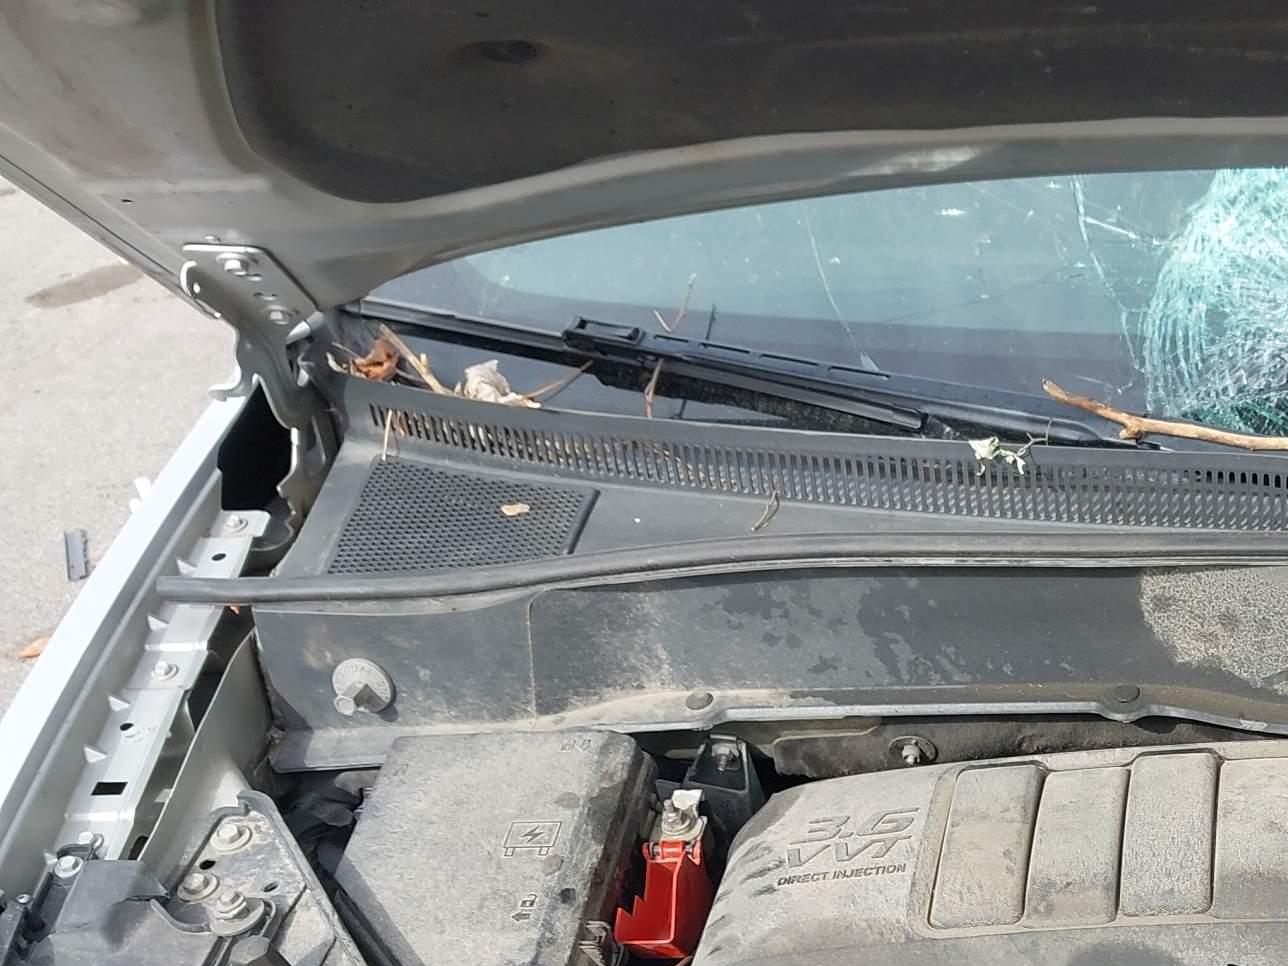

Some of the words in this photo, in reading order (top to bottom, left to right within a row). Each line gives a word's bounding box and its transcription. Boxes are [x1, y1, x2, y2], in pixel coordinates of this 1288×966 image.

[790, 807, 920, 845] 3.6
[787, 835, 912, 868] VVT
[777, 871, 829, 886] DIRECT
[831, 863, 907, 881] INJECTION
